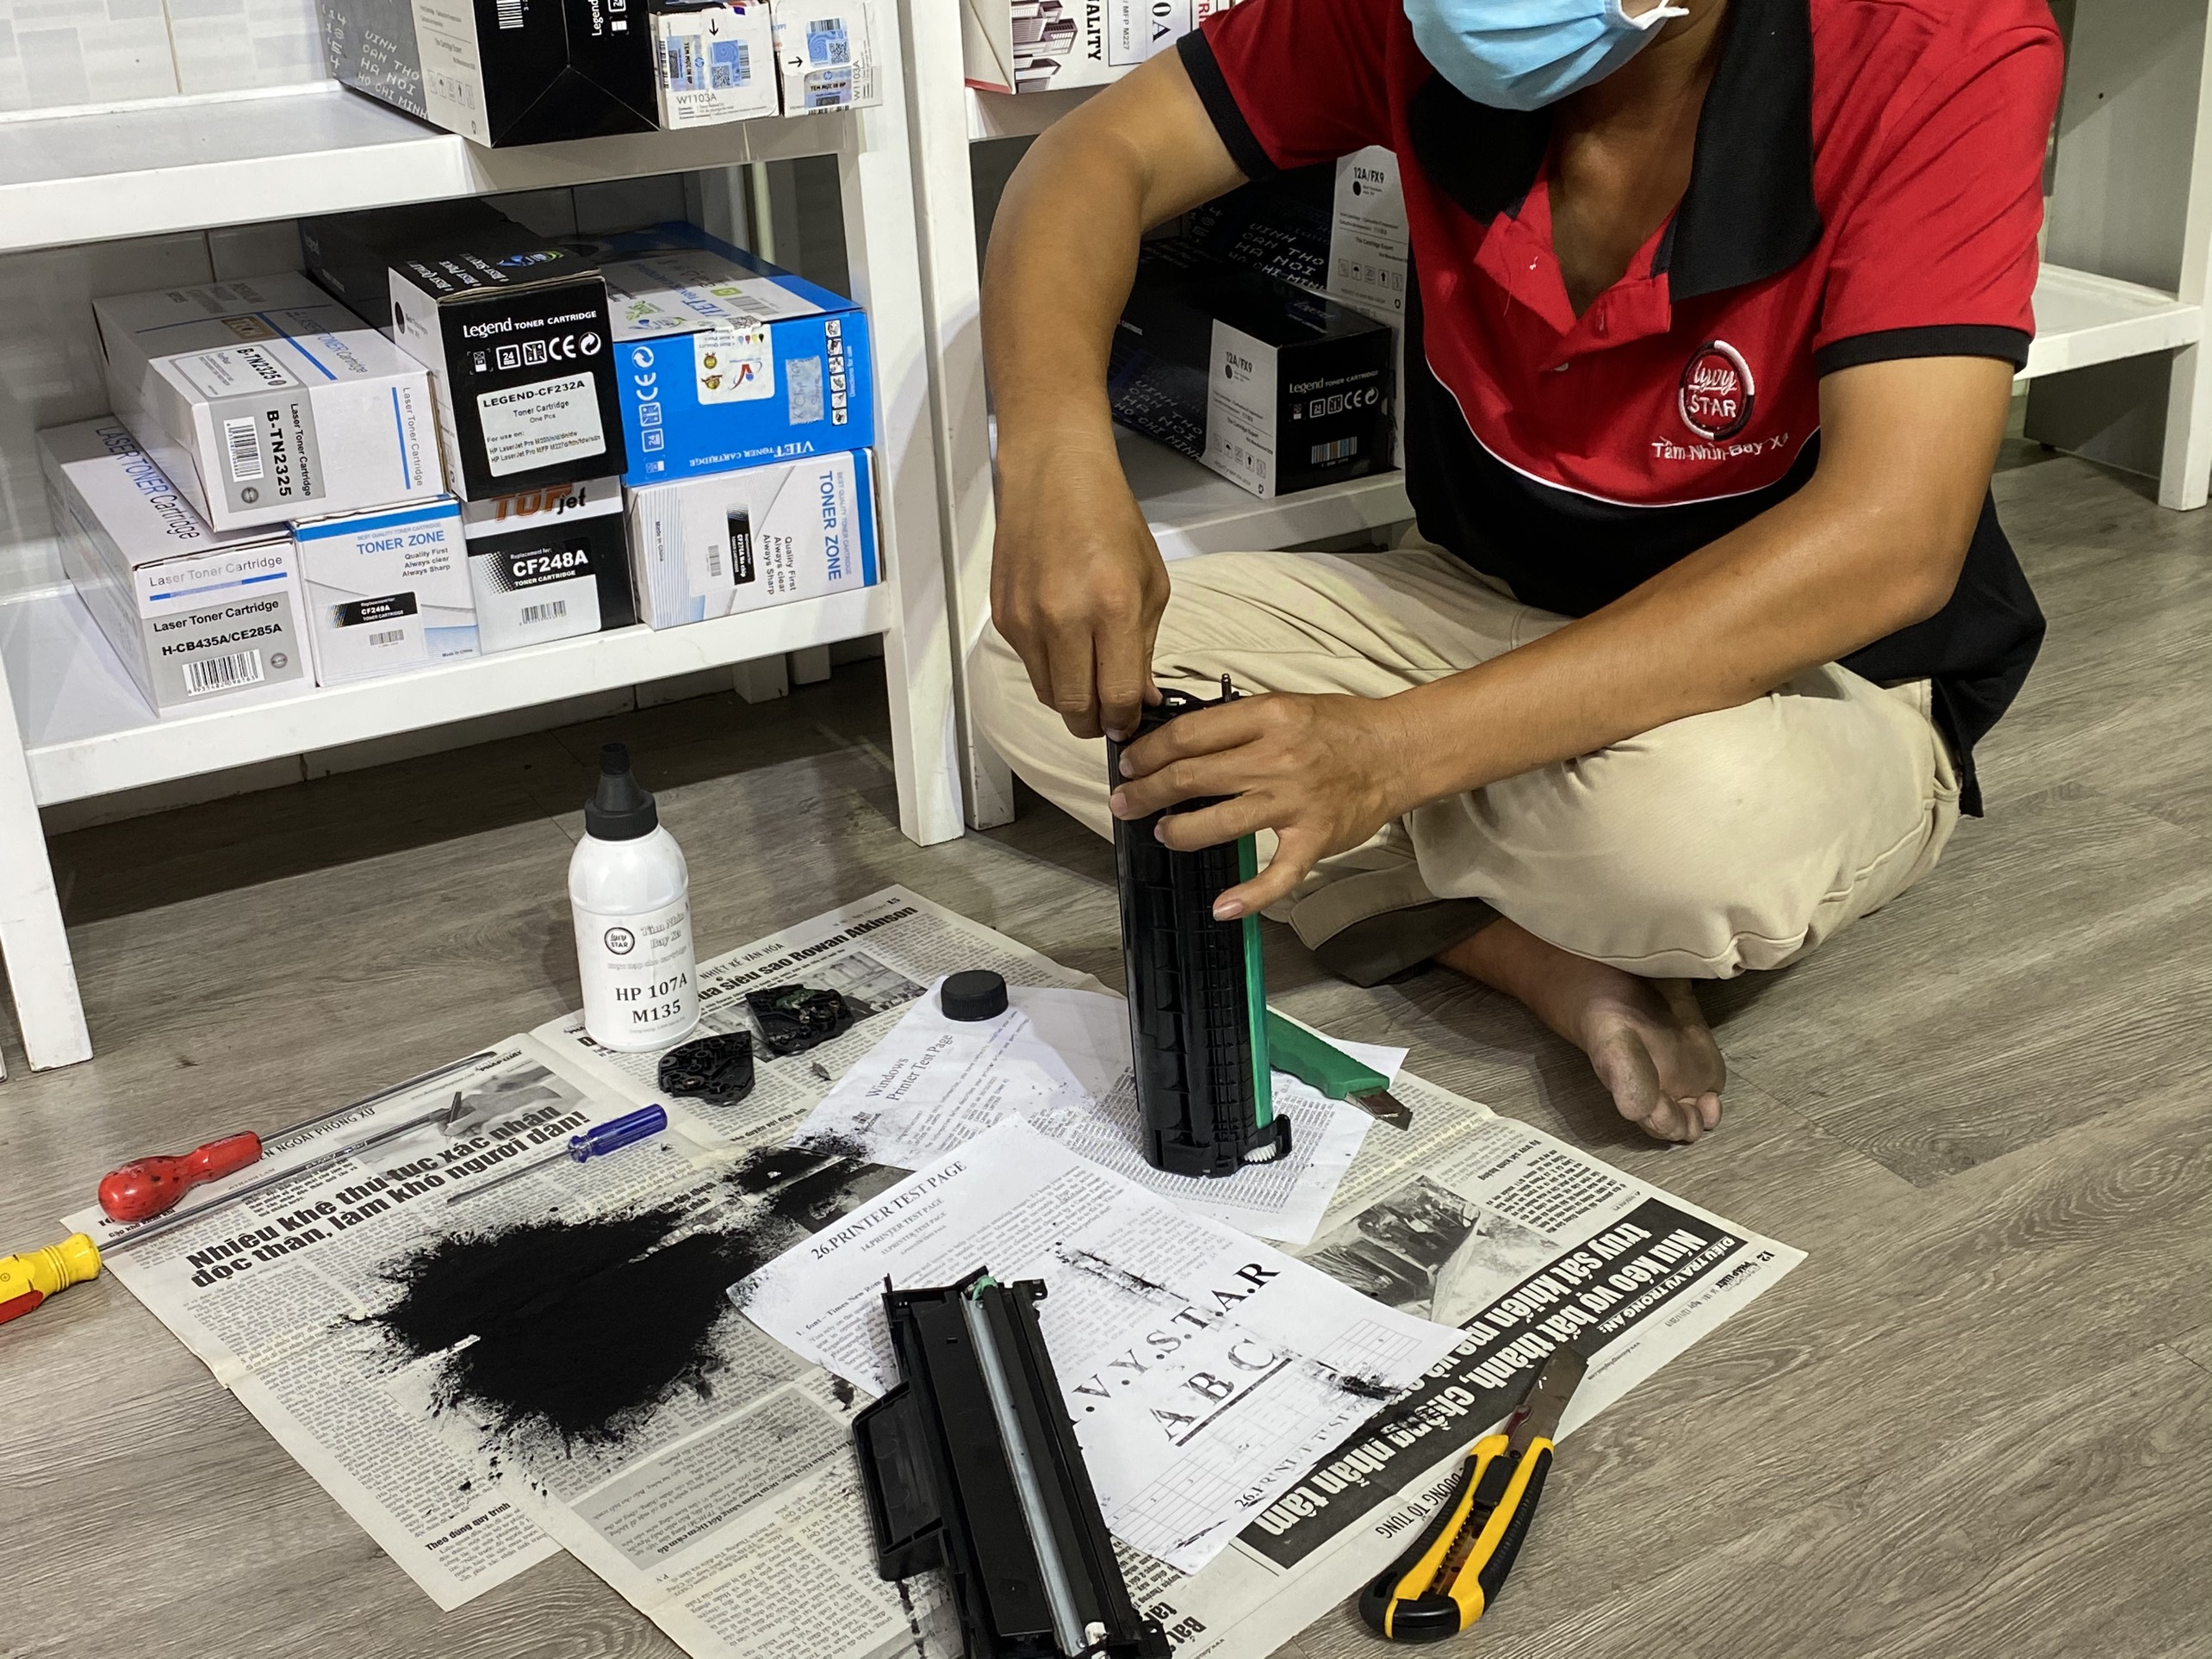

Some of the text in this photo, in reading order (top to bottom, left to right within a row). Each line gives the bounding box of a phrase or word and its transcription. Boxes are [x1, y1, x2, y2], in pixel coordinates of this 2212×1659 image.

[676, 94, 718, 104] W1103A
[1354, 167, 1384, 183] 12A/FX9
[463, 310, 597, 339] Legend TONER CARTRIDGE
[237, 347, 282, 382] B-TN2325
[1226, 351, 1252, 373] 12A/FX9
[482, 380, 585, 407] LEGEND-CF232A
[1289, 377, 1324, 395] Legend
[513, 401, 569, 418] Toner Cartridge
[1687, 395, 1737, 418] STAR
[290, 403, 312, 496] Laser Toner Cartridge
[402, 388, 424, 486] Laser Toner Cartridge
[1689, 442, 1726, 461] Nhìn
[1729, 442, 1763, 457] Bay
[266, 410, 292, 497] B-TN2325
[689, 440, 815, 468] VIET TONER CARTRIDGE
[96, 426, 200, 539] LASER TONER Cartridge
[412, 523, 441, 531] CARTRIDGE
[818, 470, 842, 581] TONER ZONE
[357, 531, 445, 555] TONER ZONE
[405, 551, 430, 560] Quality
[763, 534, 772, 566] Always
[785, 536, 794, 569] Quality
[149, 556, 283, 587] Laser Toner Cartridge
[402, 564, 450, 577] Always Sharp
[405, 560, 430, 569] Always
[513, 550, 589, 577] CF248A
[515, 569, 575, 587] TONER CARTRIDGE
[153, 600, 279, 632] Laser Toner Cartridge
[162, 624, 283, 656] H-CB435A/CE285A
[719, 905, 919, 992] siêu sao Rowan Atkinson
[615, 972, 687, 1001] HP 107A
[632, 999, 680, 1023] M135
[866, 1058, 909, 1097] Windows
[885, 1035, 954, 1101] Printer Test Page
[251, 1223, 333, 1264] thân,
[328, 1195, 391, 1230] làm
[386, 1173, 445, 1203] khó
[444, 1138, 530, 1180] người
[525, 1110, 591, 1145] dân!
[276, 1199, 338, 1233] khê
[336, 1176, 389, 1205] thủ
[386, 1157, 438, 1181] tục
[436, 1135, 491, 1163] xác
[811, 1160, 966, 1260] 26.PRINTER TEST PAGE
[904, 1209, 923, 1225] TEST
[923, 1197, 944, 1214] PAGE
[1648, 1228, 1709, 1264] Níu
[1756, 1251, 1775, 1261] 12
[1483, 1221, 1653, 1330] truy sát khiến
[1610, 1254, 1672, 1293] kéo
[1577, 1284, 1625, 1314] vợ
[1627, 1283, 1669, 1320] TRỌNG
[805, 1319, 822, 1330] font
[827, 1302, 848, 1316] Times
[1544, 1304, 1600, 1345] bất
[1458, 1331, 1556, 1389] thành,
[1310, 1437, 1397, 1494] nhẫn
[425, 1502, 511, 1550] Theo đúng quy trình
[1253, 1485, 1331, 1537] tâm
[1375, 1509, 1414, 1540] TỤNG
